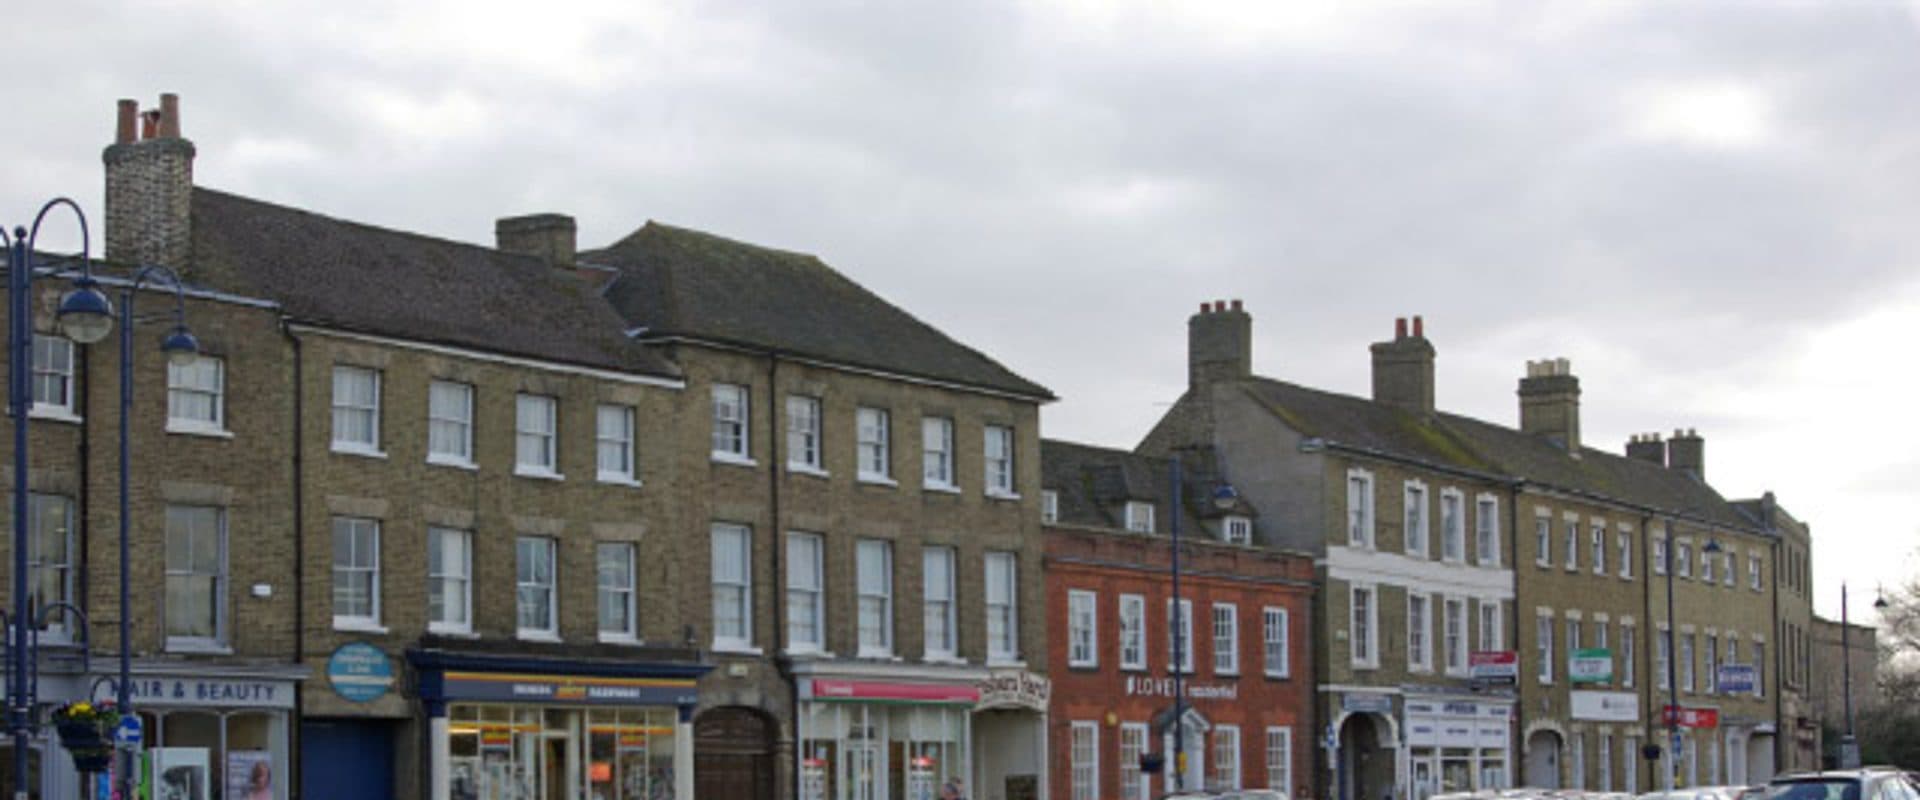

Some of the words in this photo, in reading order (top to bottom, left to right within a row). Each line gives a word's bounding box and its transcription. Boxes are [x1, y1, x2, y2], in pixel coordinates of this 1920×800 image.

[111, 679, 162, 698] HAIR
[173, 680, 185, 699] &
[196, 681, 274, 701] BEAUTY
